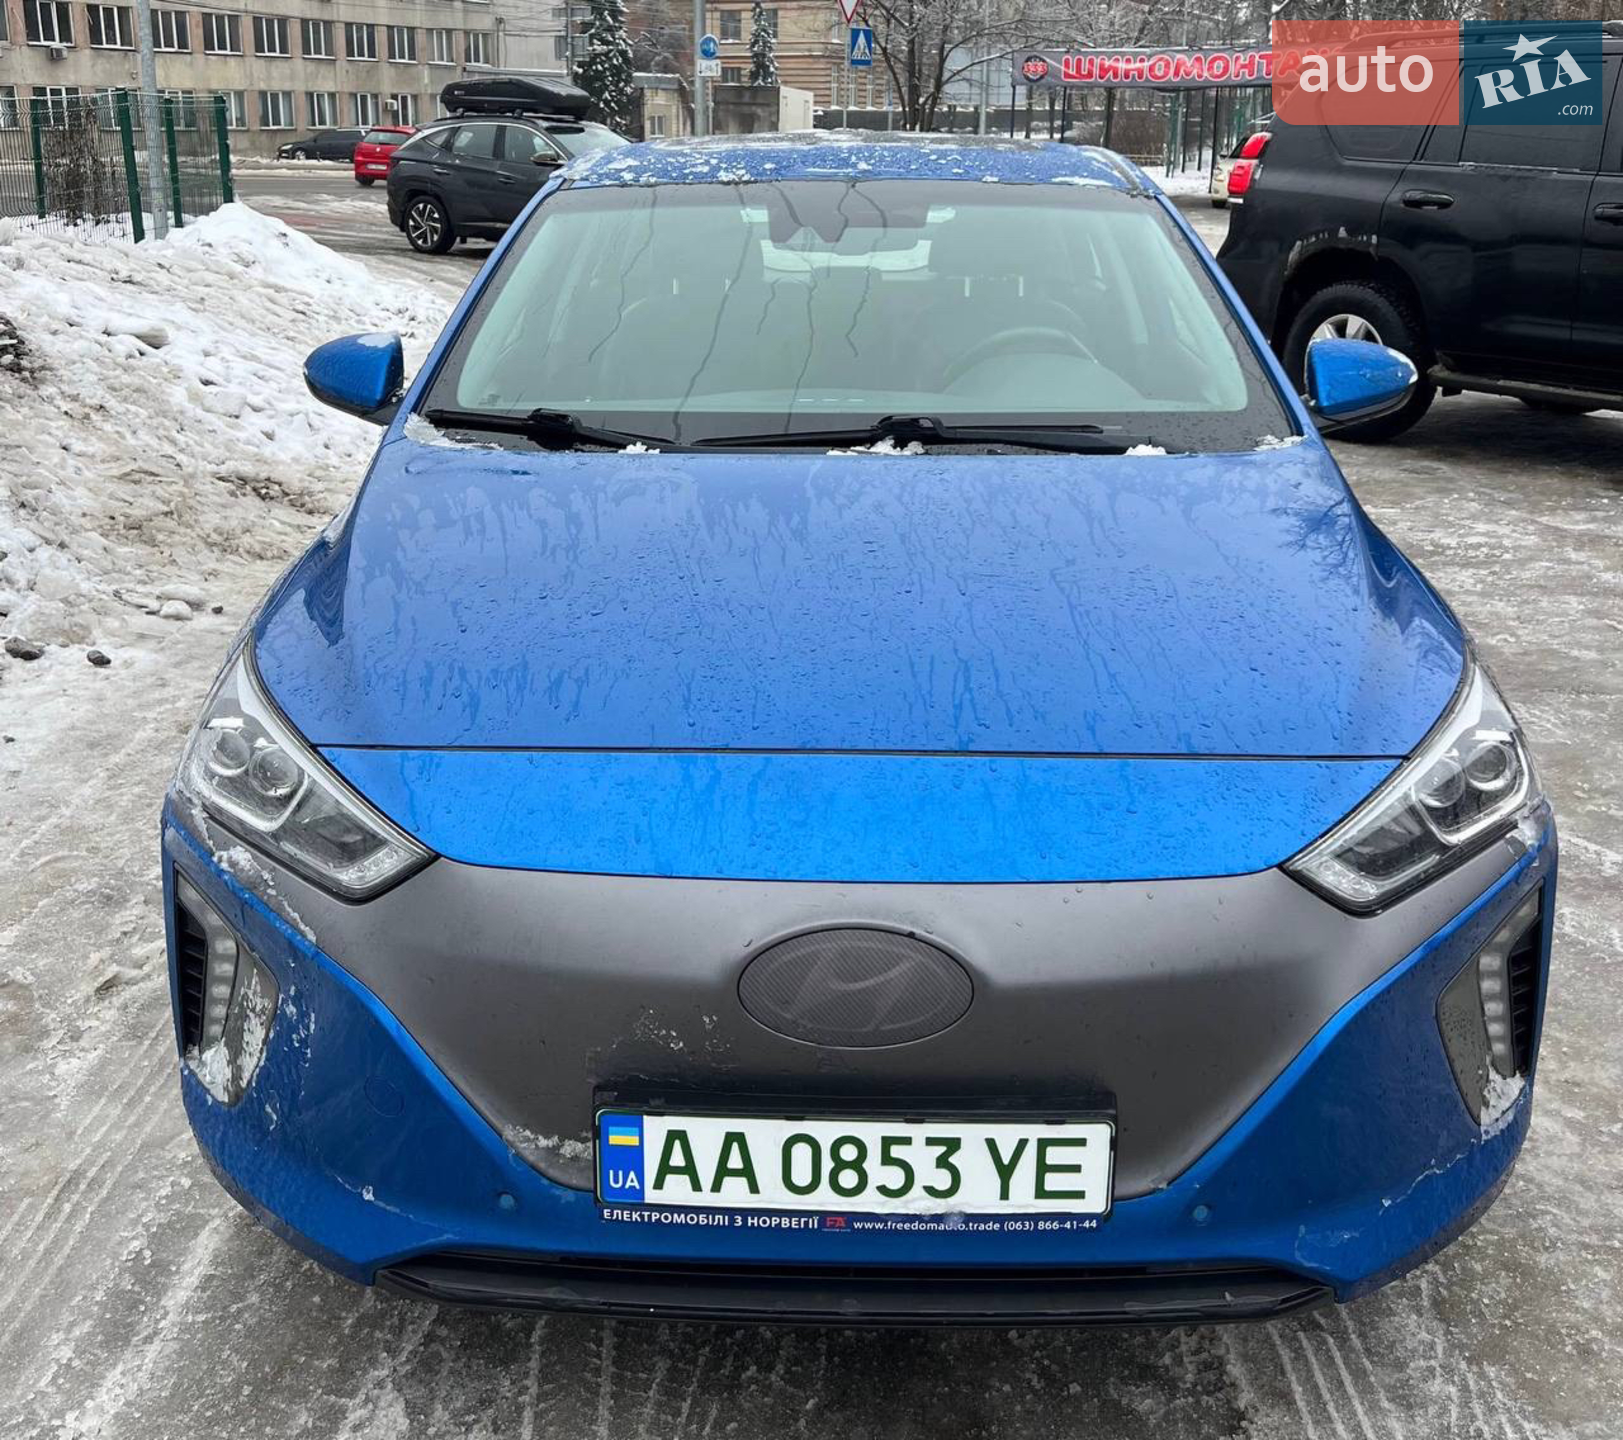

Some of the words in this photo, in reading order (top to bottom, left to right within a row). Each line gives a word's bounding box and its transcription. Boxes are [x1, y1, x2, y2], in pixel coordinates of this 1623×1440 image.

[652, 1129, 760, 1194] AA
[782, 1132, 962, 1198] 0853
[984, 1137, 1087, 1200] YE
[609, 1170, 640, 1190] UA
[603, 1208, 729, 1226] ЕЛЕКТРОМОБІЛІ
[747, 1215, 819, 1229] НОРВЕГІЇ
[1003, 1220, 1034, 1231] (063)
[1037, 1218, 1097, 1230] 866-41-44
